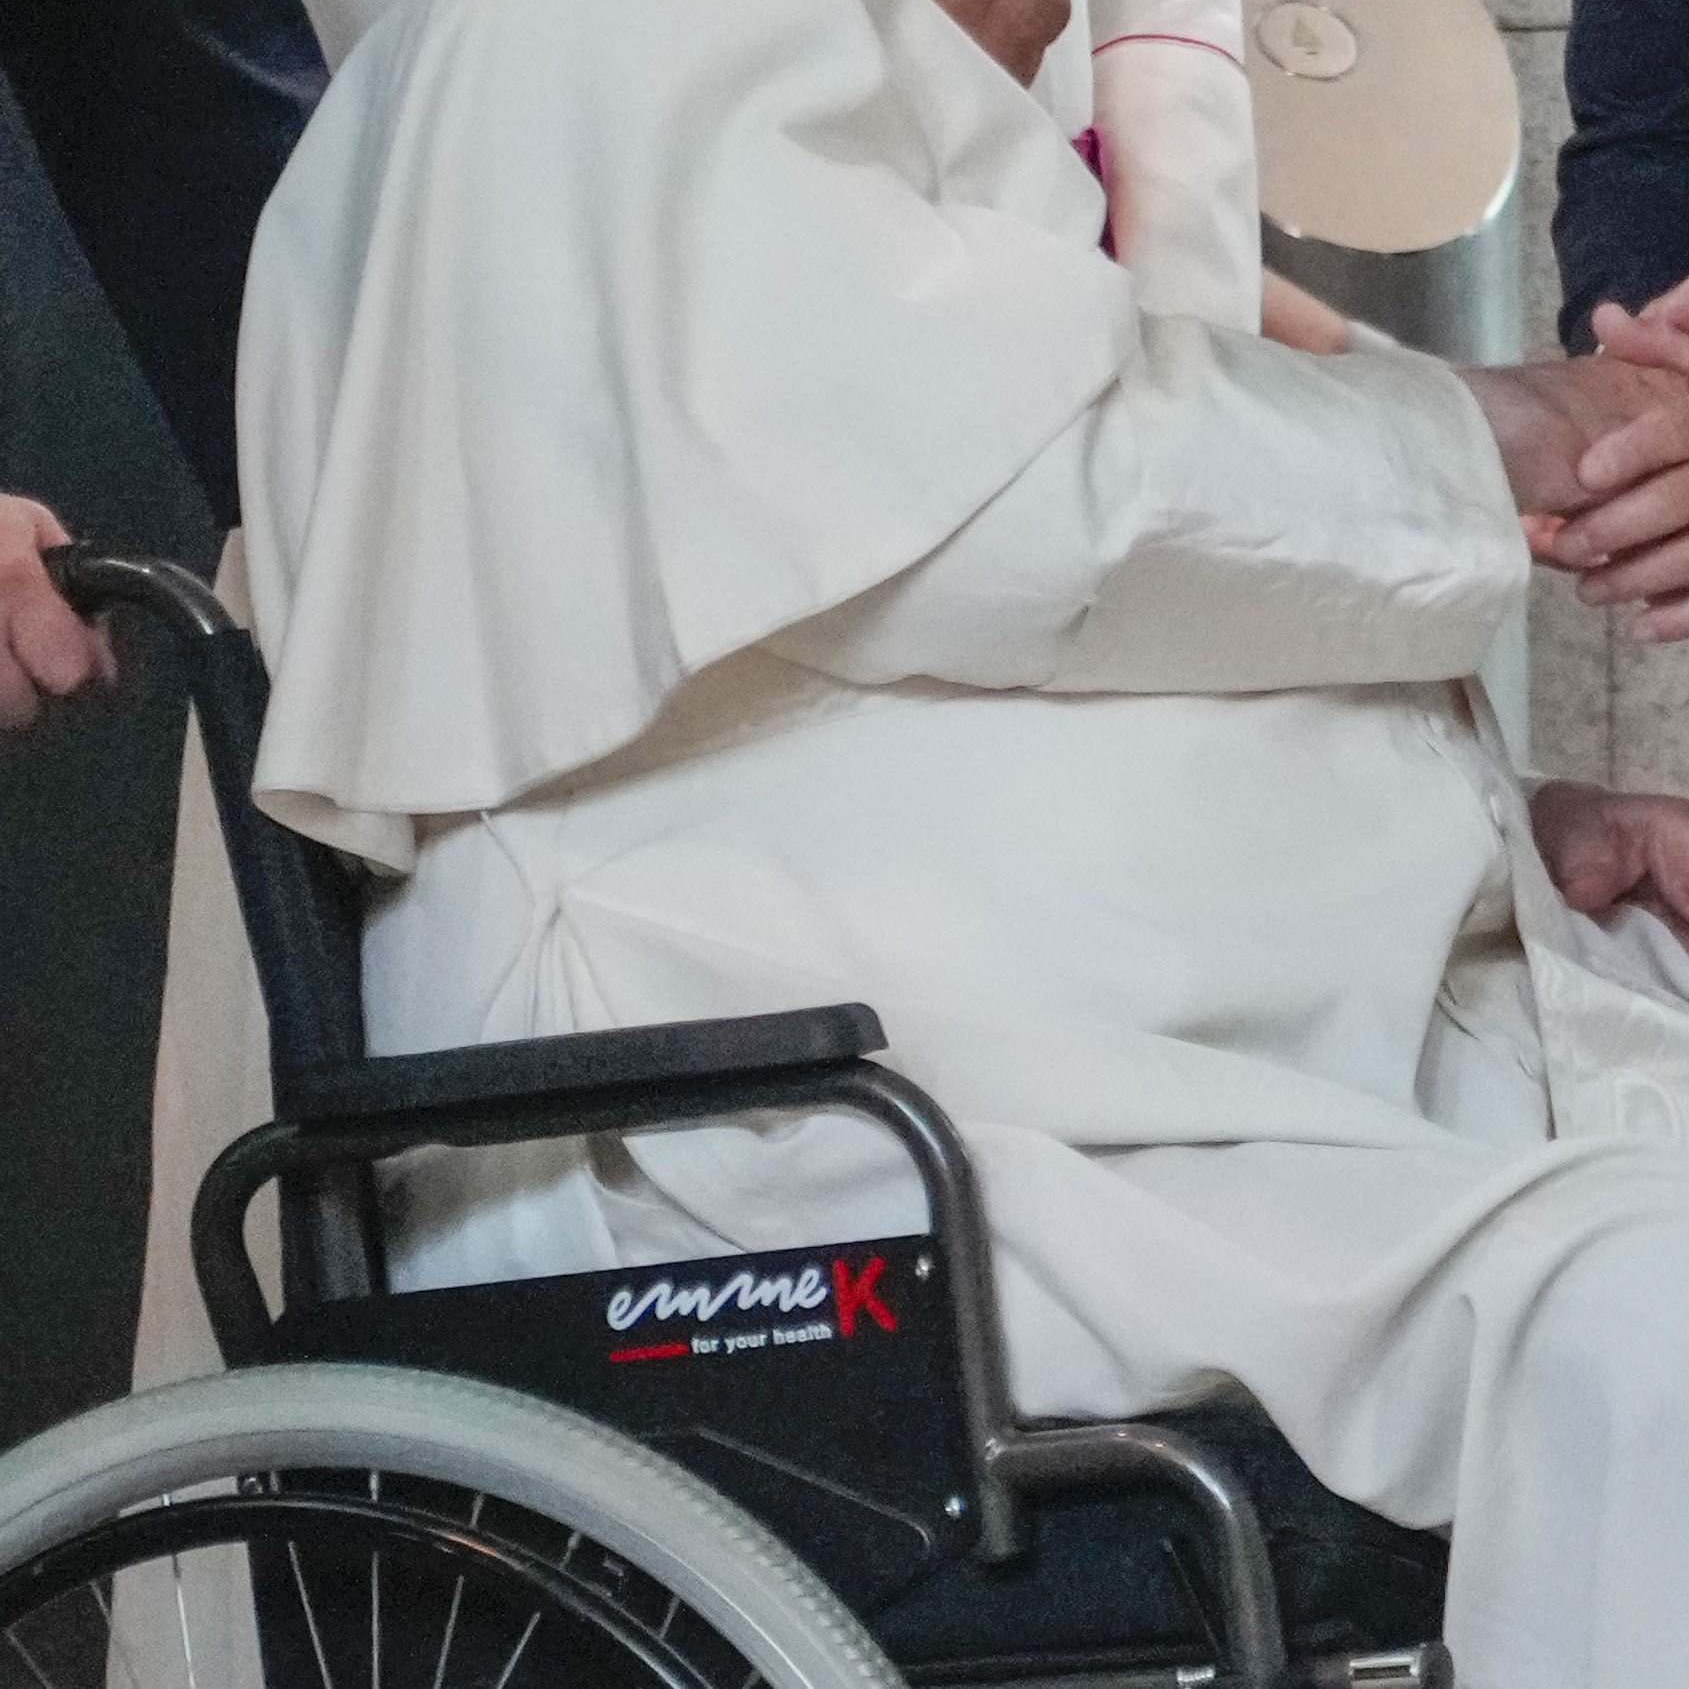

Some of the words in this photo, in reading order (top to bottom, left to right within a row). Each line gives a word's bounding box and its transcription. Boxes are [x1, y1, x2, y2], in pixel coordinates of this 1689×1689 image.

[691, 1335, 720, 1354] for
[726, 1332, 768, 1354] your
[772, 1322, 832, 1345] health
